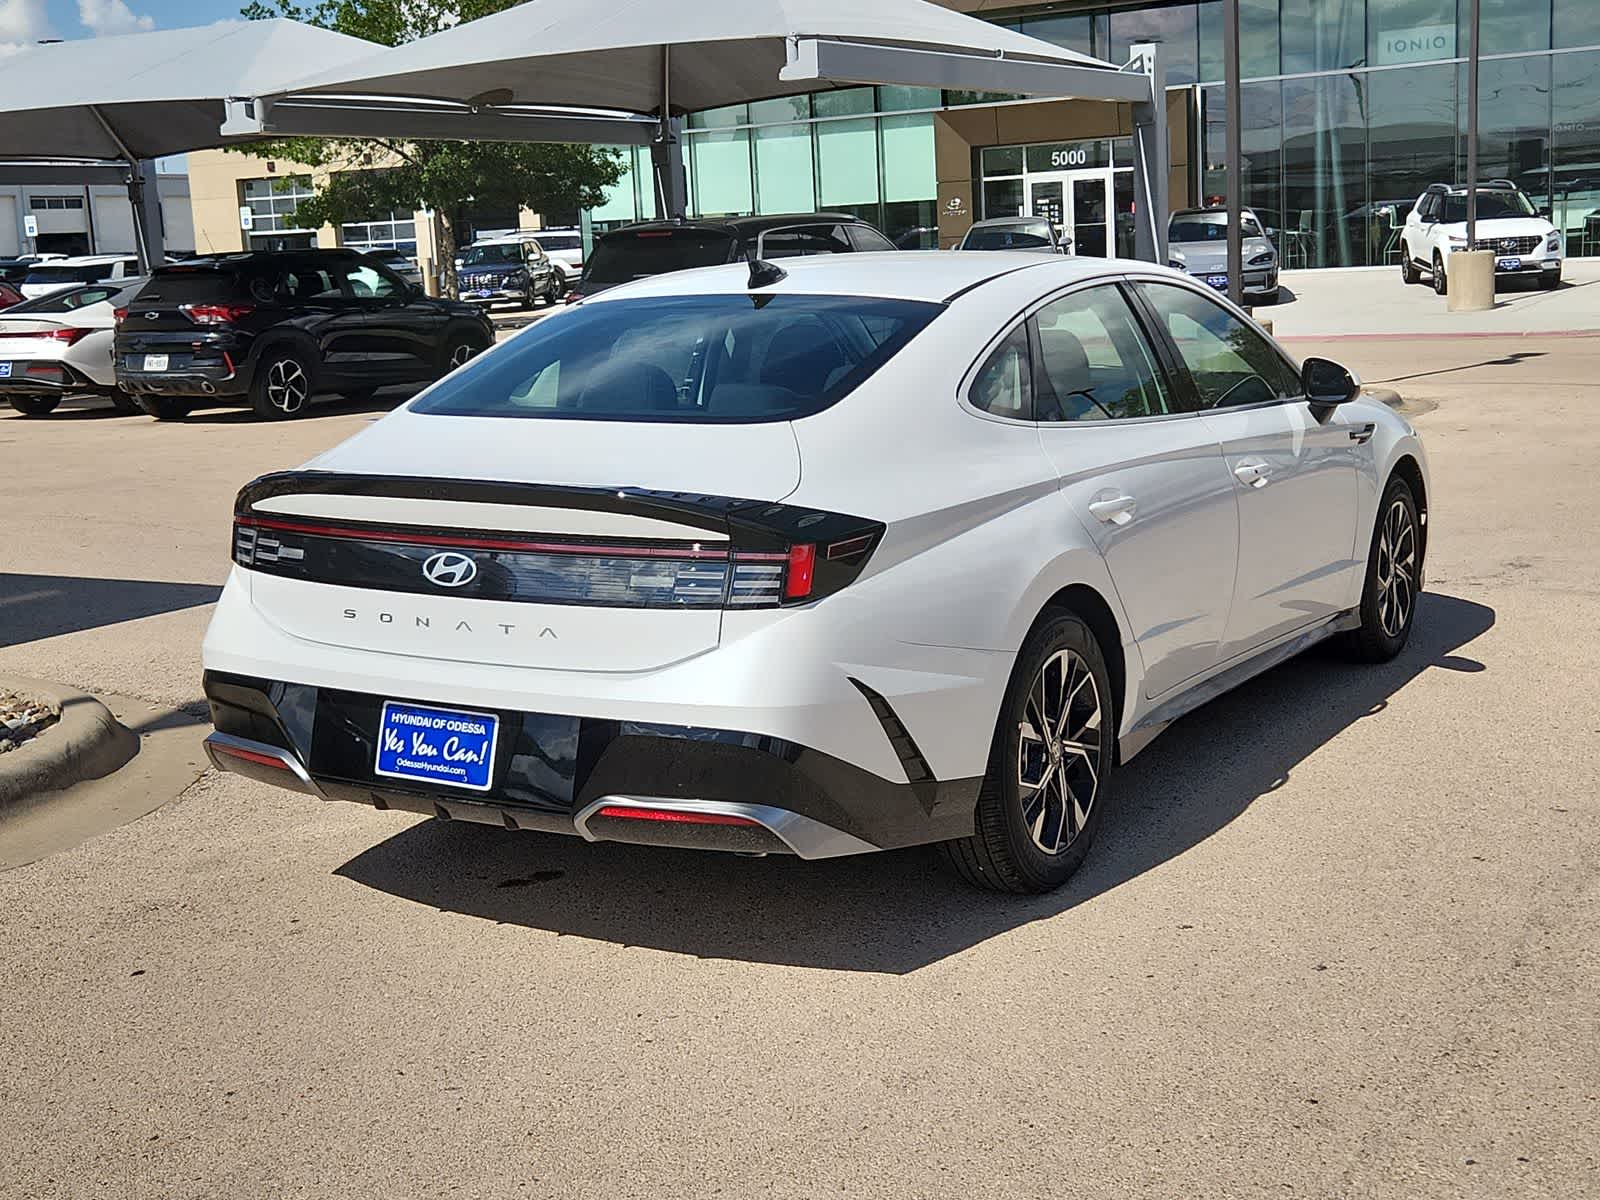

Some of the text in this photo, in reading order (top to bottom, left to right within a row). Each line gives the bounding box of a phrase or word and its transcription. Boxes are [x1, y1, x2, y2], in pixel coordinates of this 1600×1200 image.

[1051, 150, 1086, 166] 5000
[344, 608, 558, 639] SONATA
[391, 713, 486, 735] HYUNDAI OF ODESSA
[384, 727, 489, 765] Yes You Can!
[396, 758, 466, 775] OdessaHyundai.com
